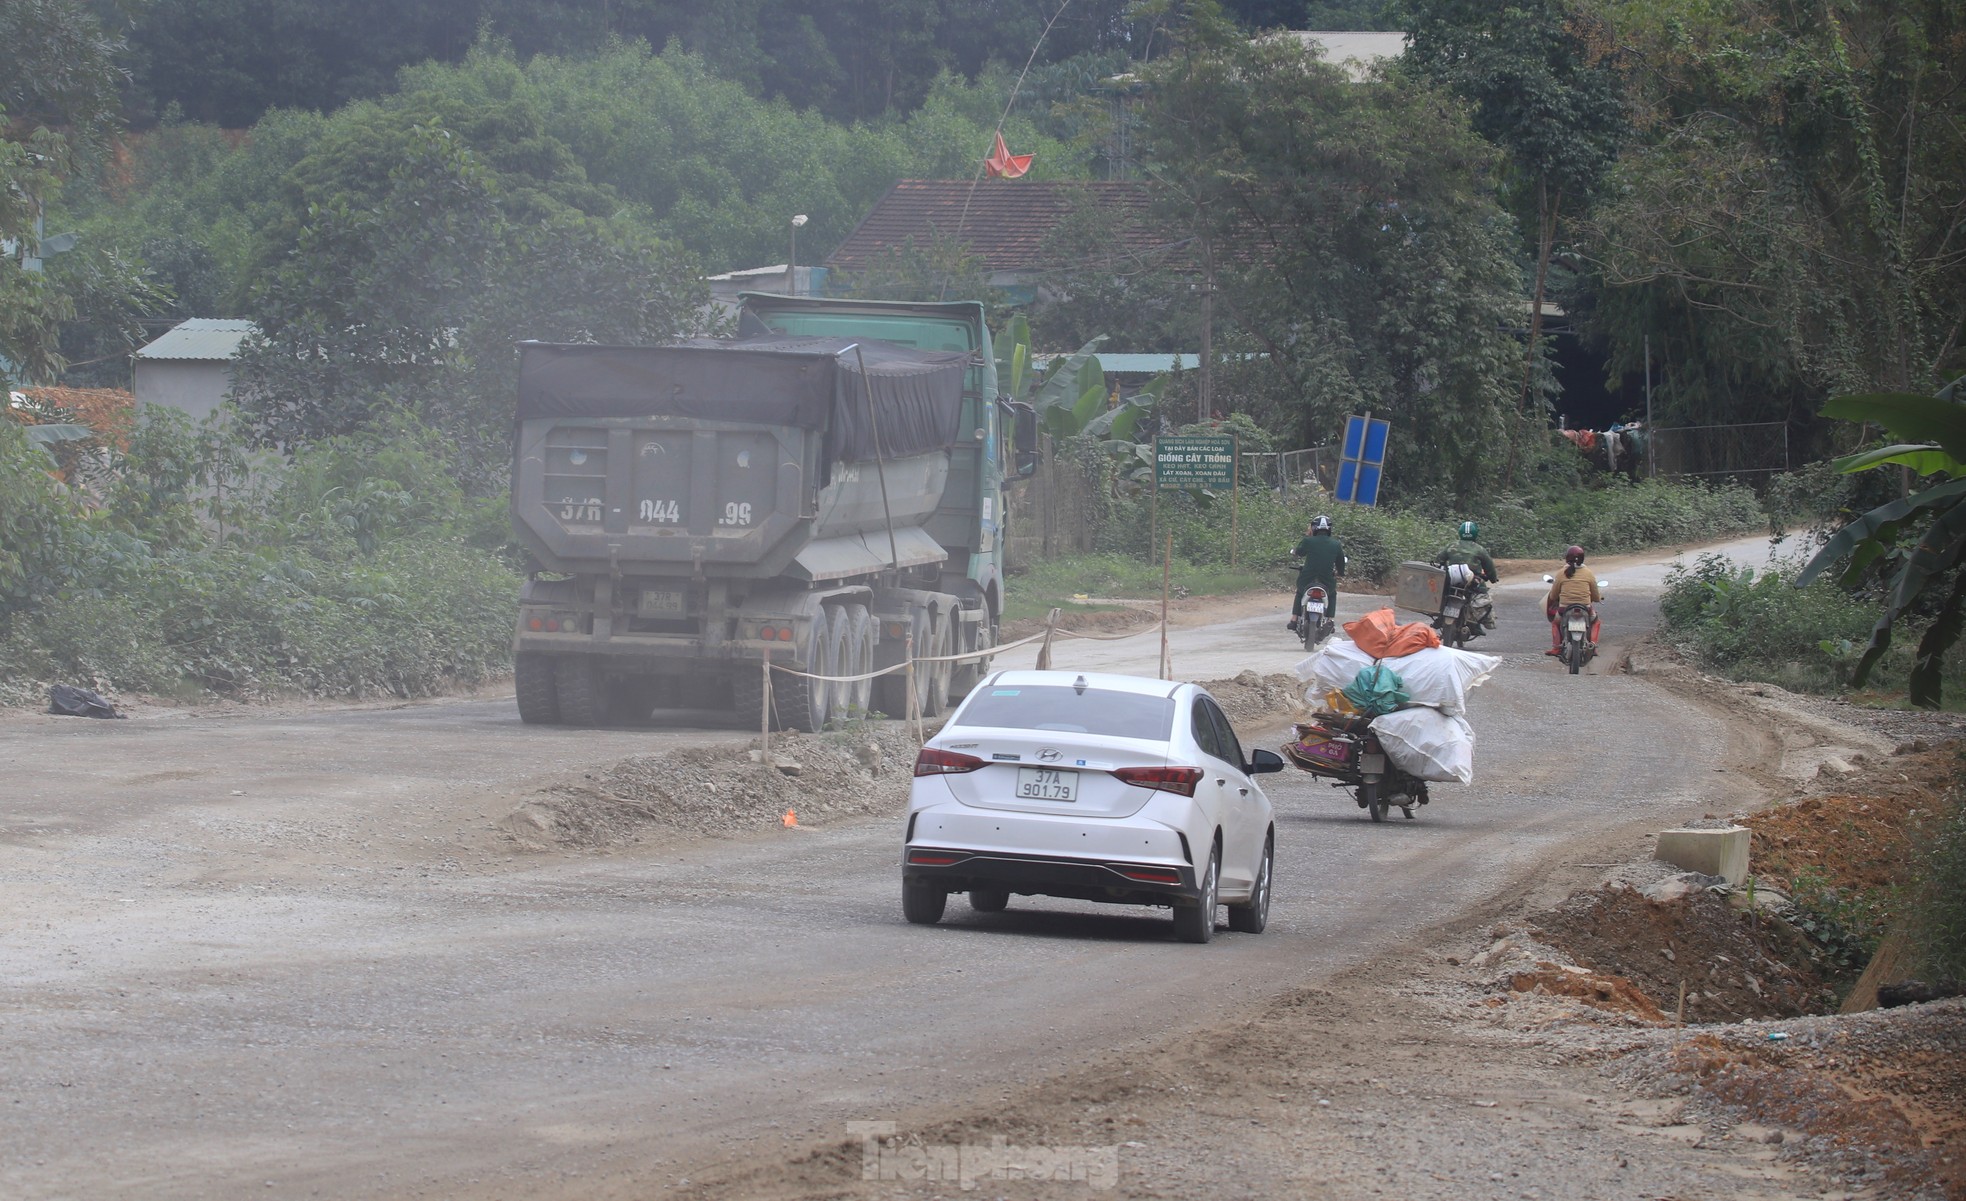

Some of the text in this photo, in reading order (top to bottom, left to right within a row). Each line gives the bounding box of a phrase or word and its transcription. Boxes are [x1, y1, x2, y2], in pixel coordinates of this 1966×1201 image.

[1158, 452, 1184, 462] GIỐNG
[1186, 453, 1201, 462] CÂY
[1035, 770, 1060, 785] 37A
[1023, 783, 1070, 799] 901.79
